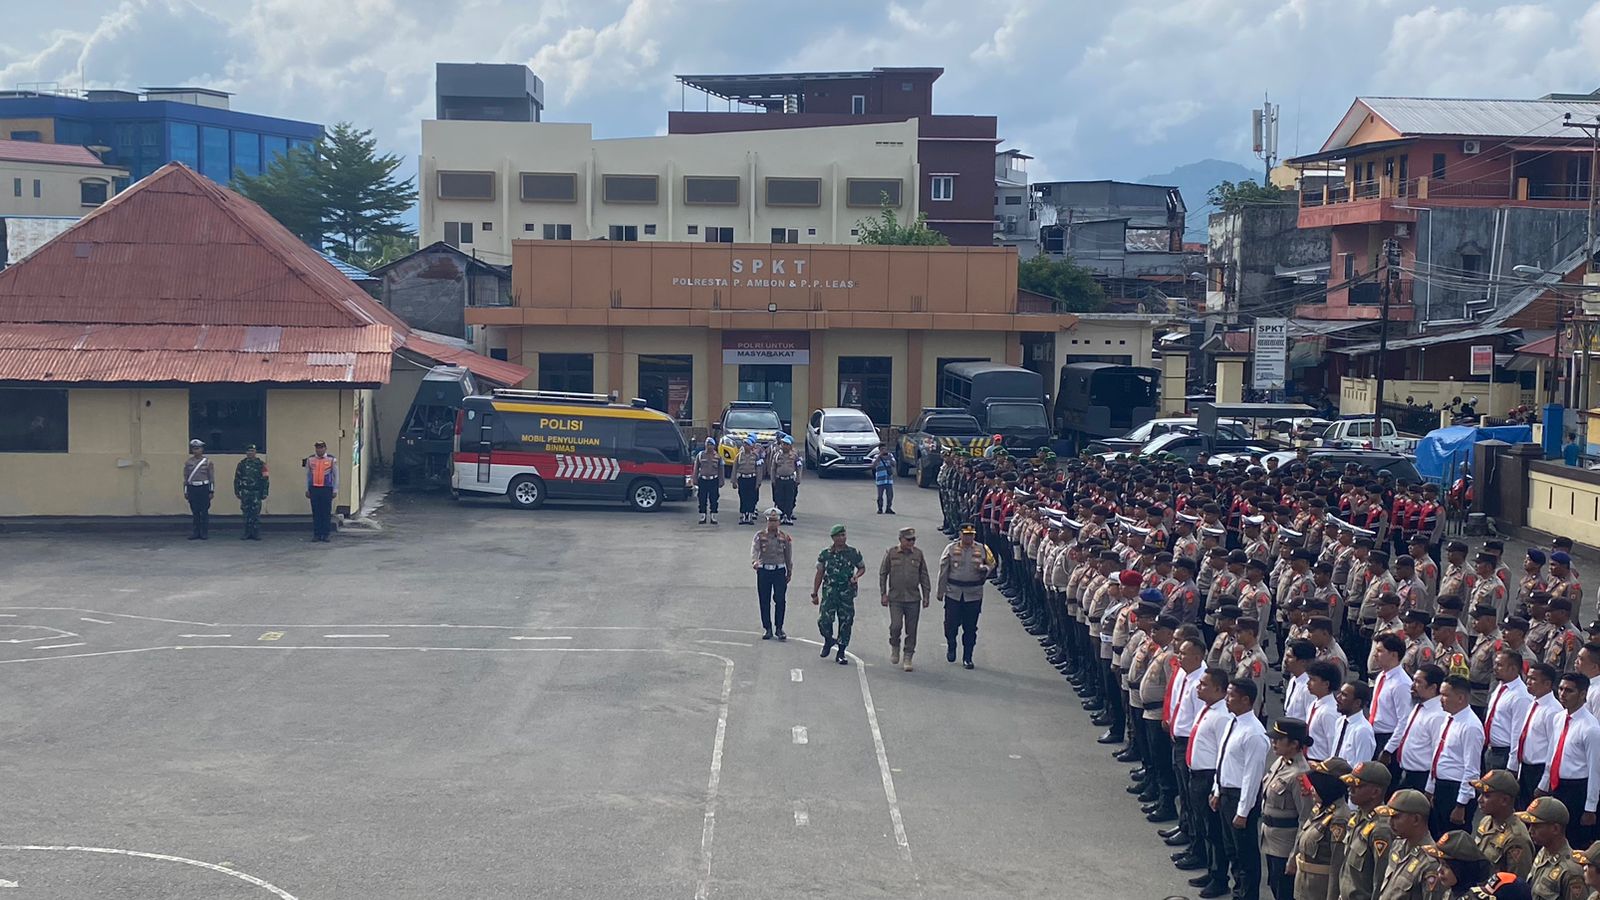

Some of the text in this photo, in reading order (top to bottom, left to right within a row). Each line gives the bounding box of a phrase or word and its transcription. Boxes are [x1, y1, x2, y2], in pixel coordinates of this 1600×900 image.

[731, 259, 806, 274] SPKT
[672, 277, 728, 287] POLRESTA
[746, 279, 785, 288] AMBON
[789, 280, 797, 288] &
[540, 418, 583, 431] POLISI
[521, 434, 600, 446] MOBIL PENYULUHAN
[545, 444, 575, 452] BINMAS
